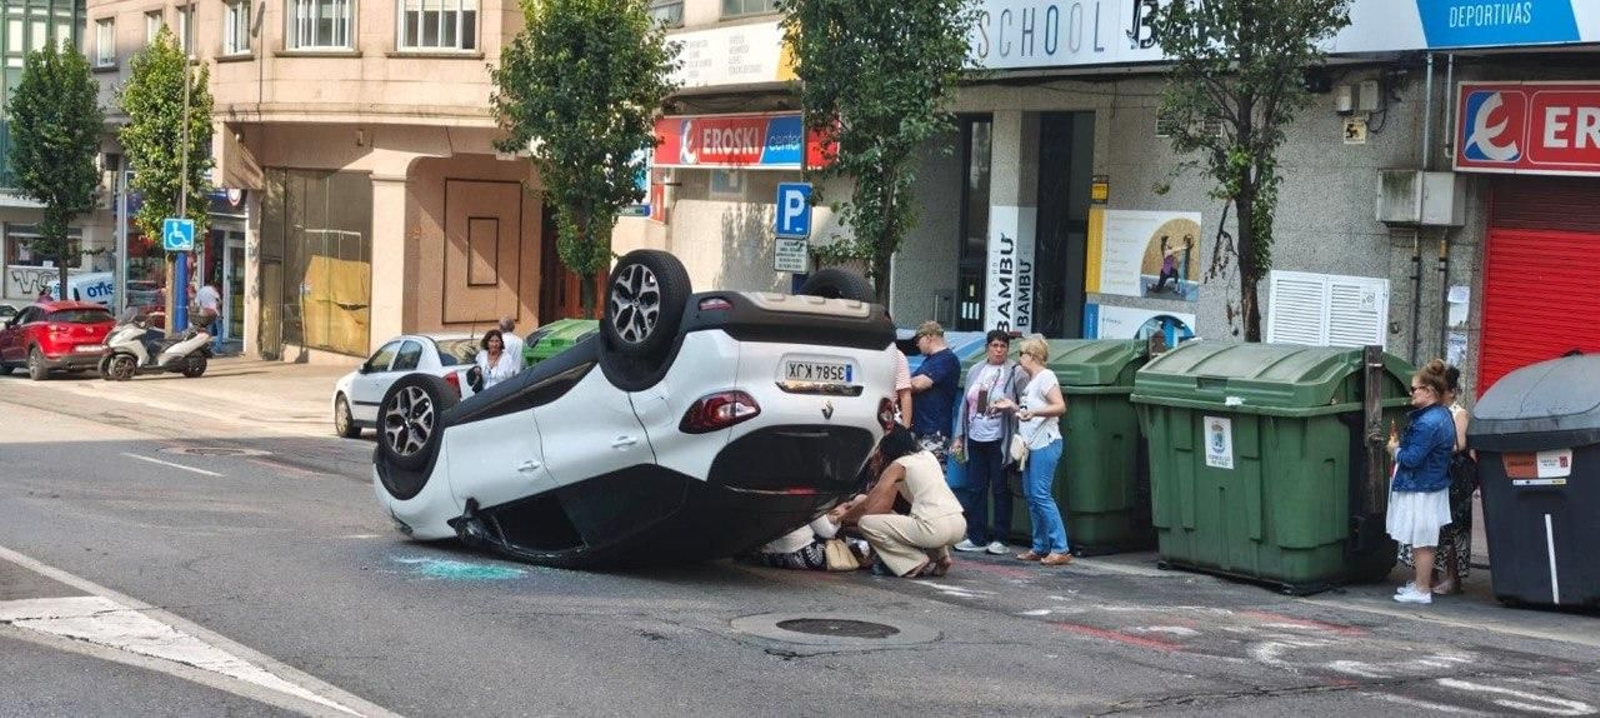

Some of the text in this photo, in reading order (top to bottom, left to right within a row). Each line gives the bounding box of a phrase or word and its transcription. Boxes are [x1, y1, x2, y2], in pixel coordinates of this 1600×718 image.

[1450, 2, 1532, 28] DEPORTIVAS
[978, 2, 1104, 59] SCHOOL
[702, 127, 759, 155] EROSKI
[784, 189, 805, 231] P
[789, 363, 845, 380] 3584 KJX
